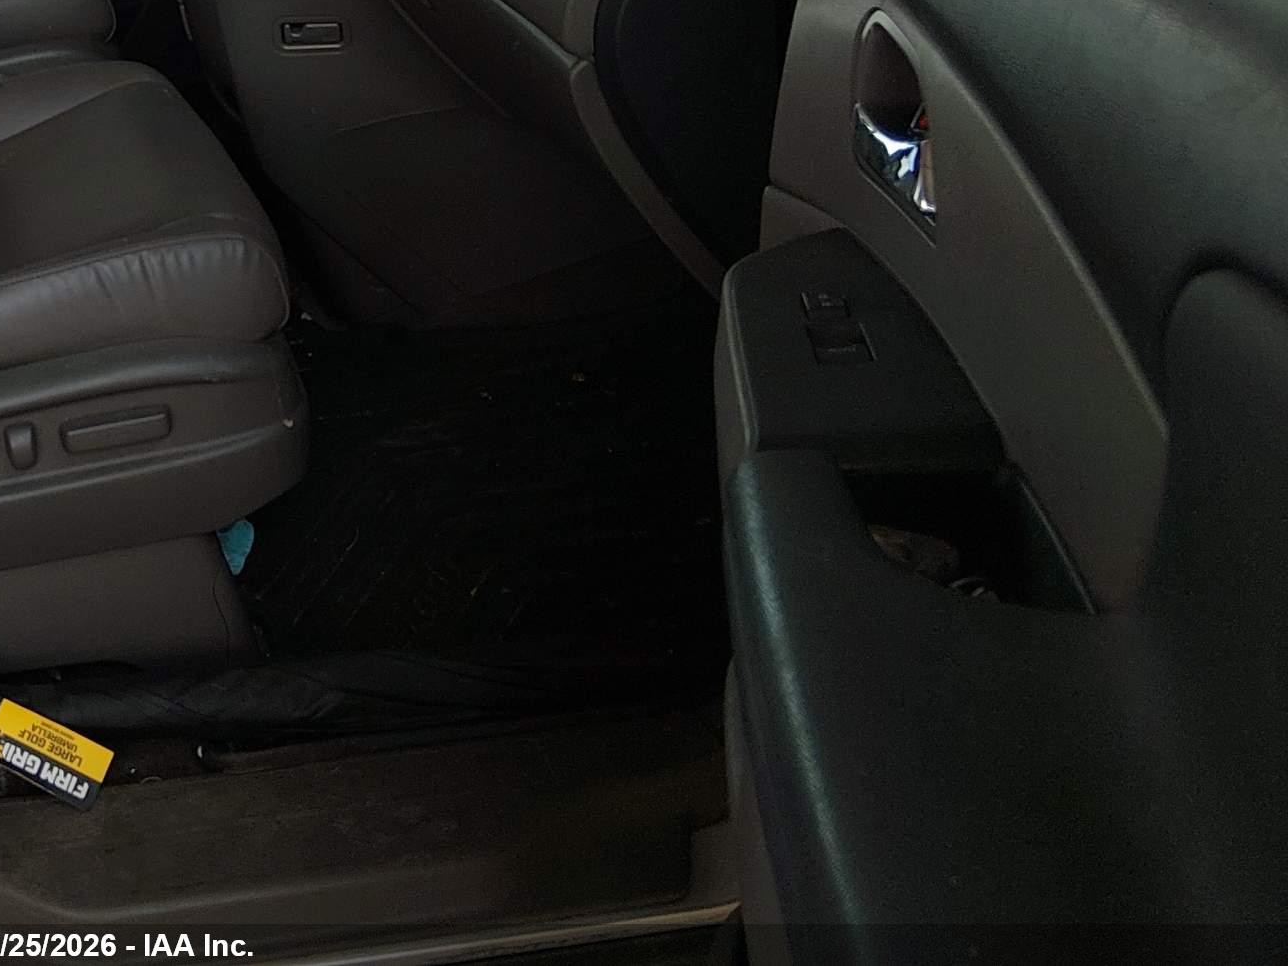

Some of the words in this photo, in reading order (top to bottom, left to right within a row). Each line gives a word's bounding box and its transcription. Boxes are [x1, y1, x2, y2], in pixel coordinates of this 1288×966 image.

[18, 729, 47, 750] GOLF
[31, 723, 78, 753] UMBRELLA
[46, 742, 83, 767] LARGE
[39, 761, 90, 800] FIRM
